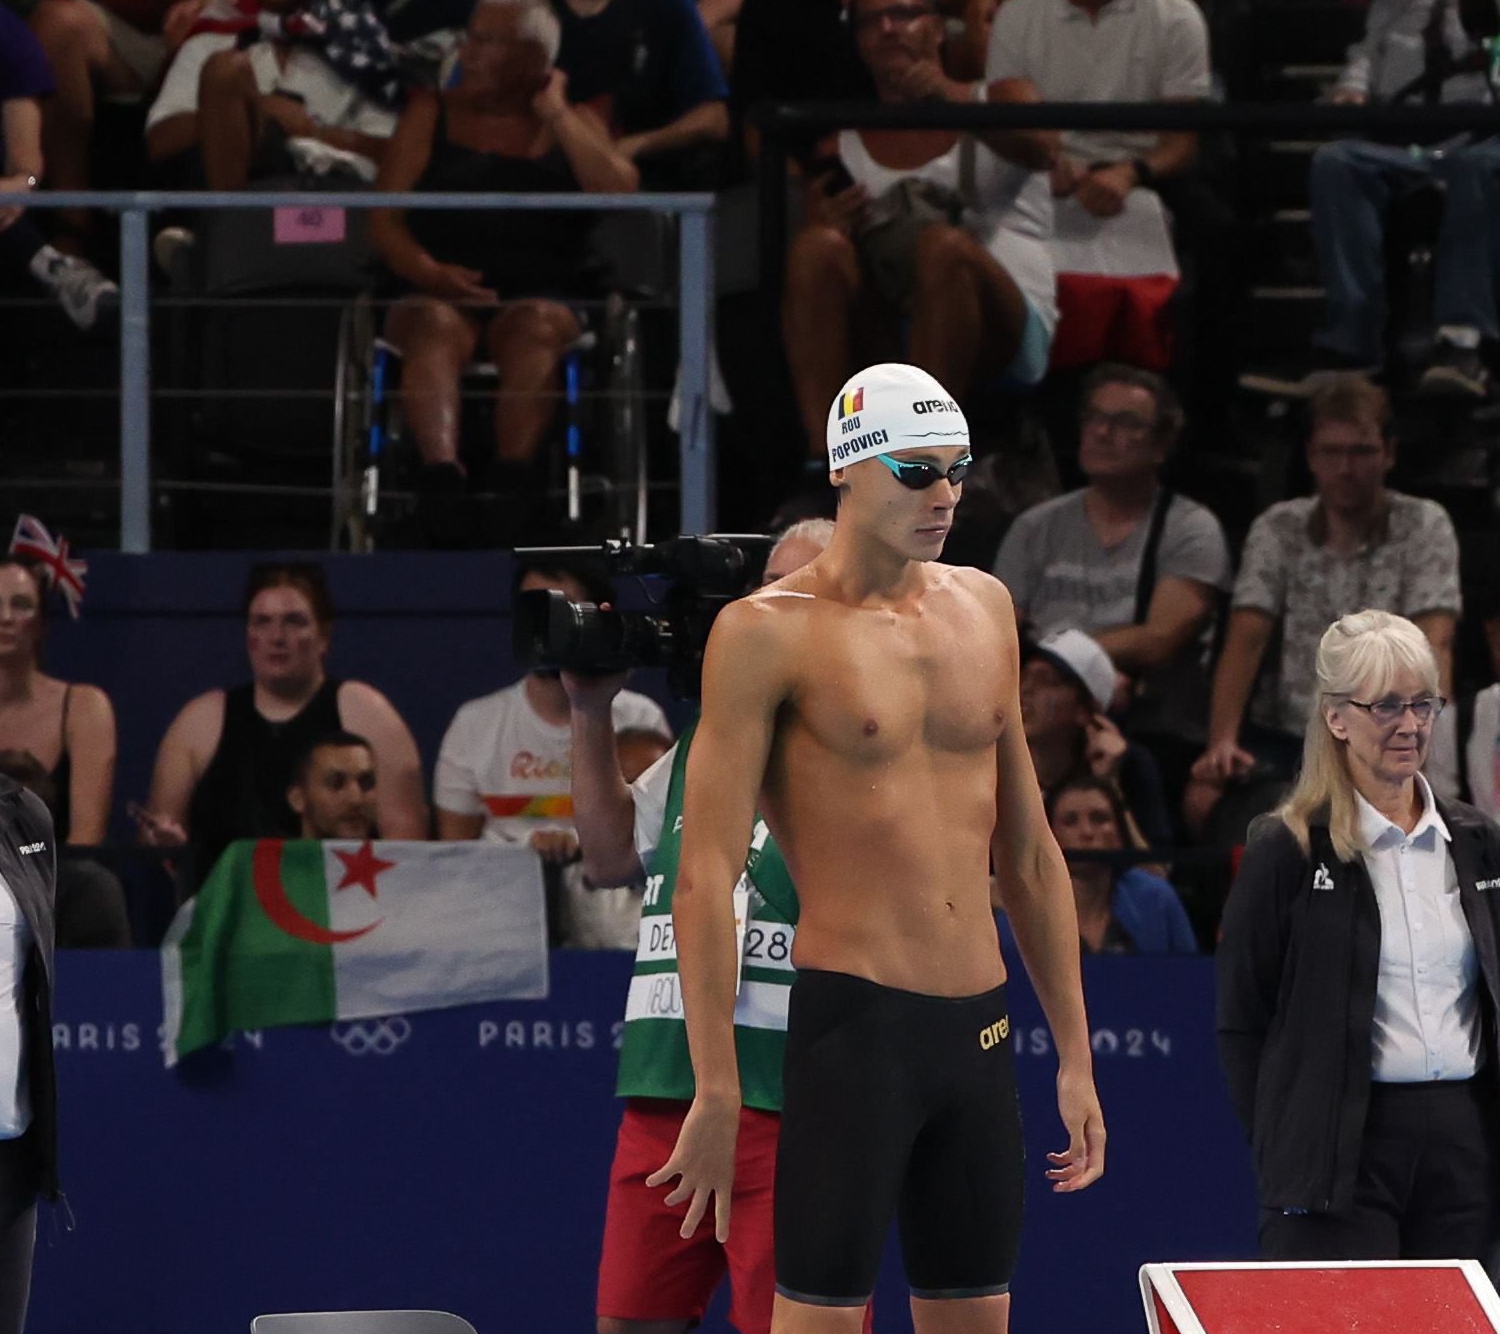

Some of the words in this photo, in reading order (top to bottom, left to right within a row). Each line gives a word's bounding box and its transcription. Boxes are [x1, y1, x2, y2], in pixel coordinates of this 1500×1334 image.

[912, 399, 960, 415] arena
[841, 416, 861, 435] ROU
[831, 429, 890, 463] POPOVICI
[745, 928, 788, 961] 28
[53, 1022, 141, 1051] ARIS
[479, 1020, 597, 1049] PARIS
[980, 1014, 1010, 1051] are
[1091, 1024, 1173, 1056] 024
